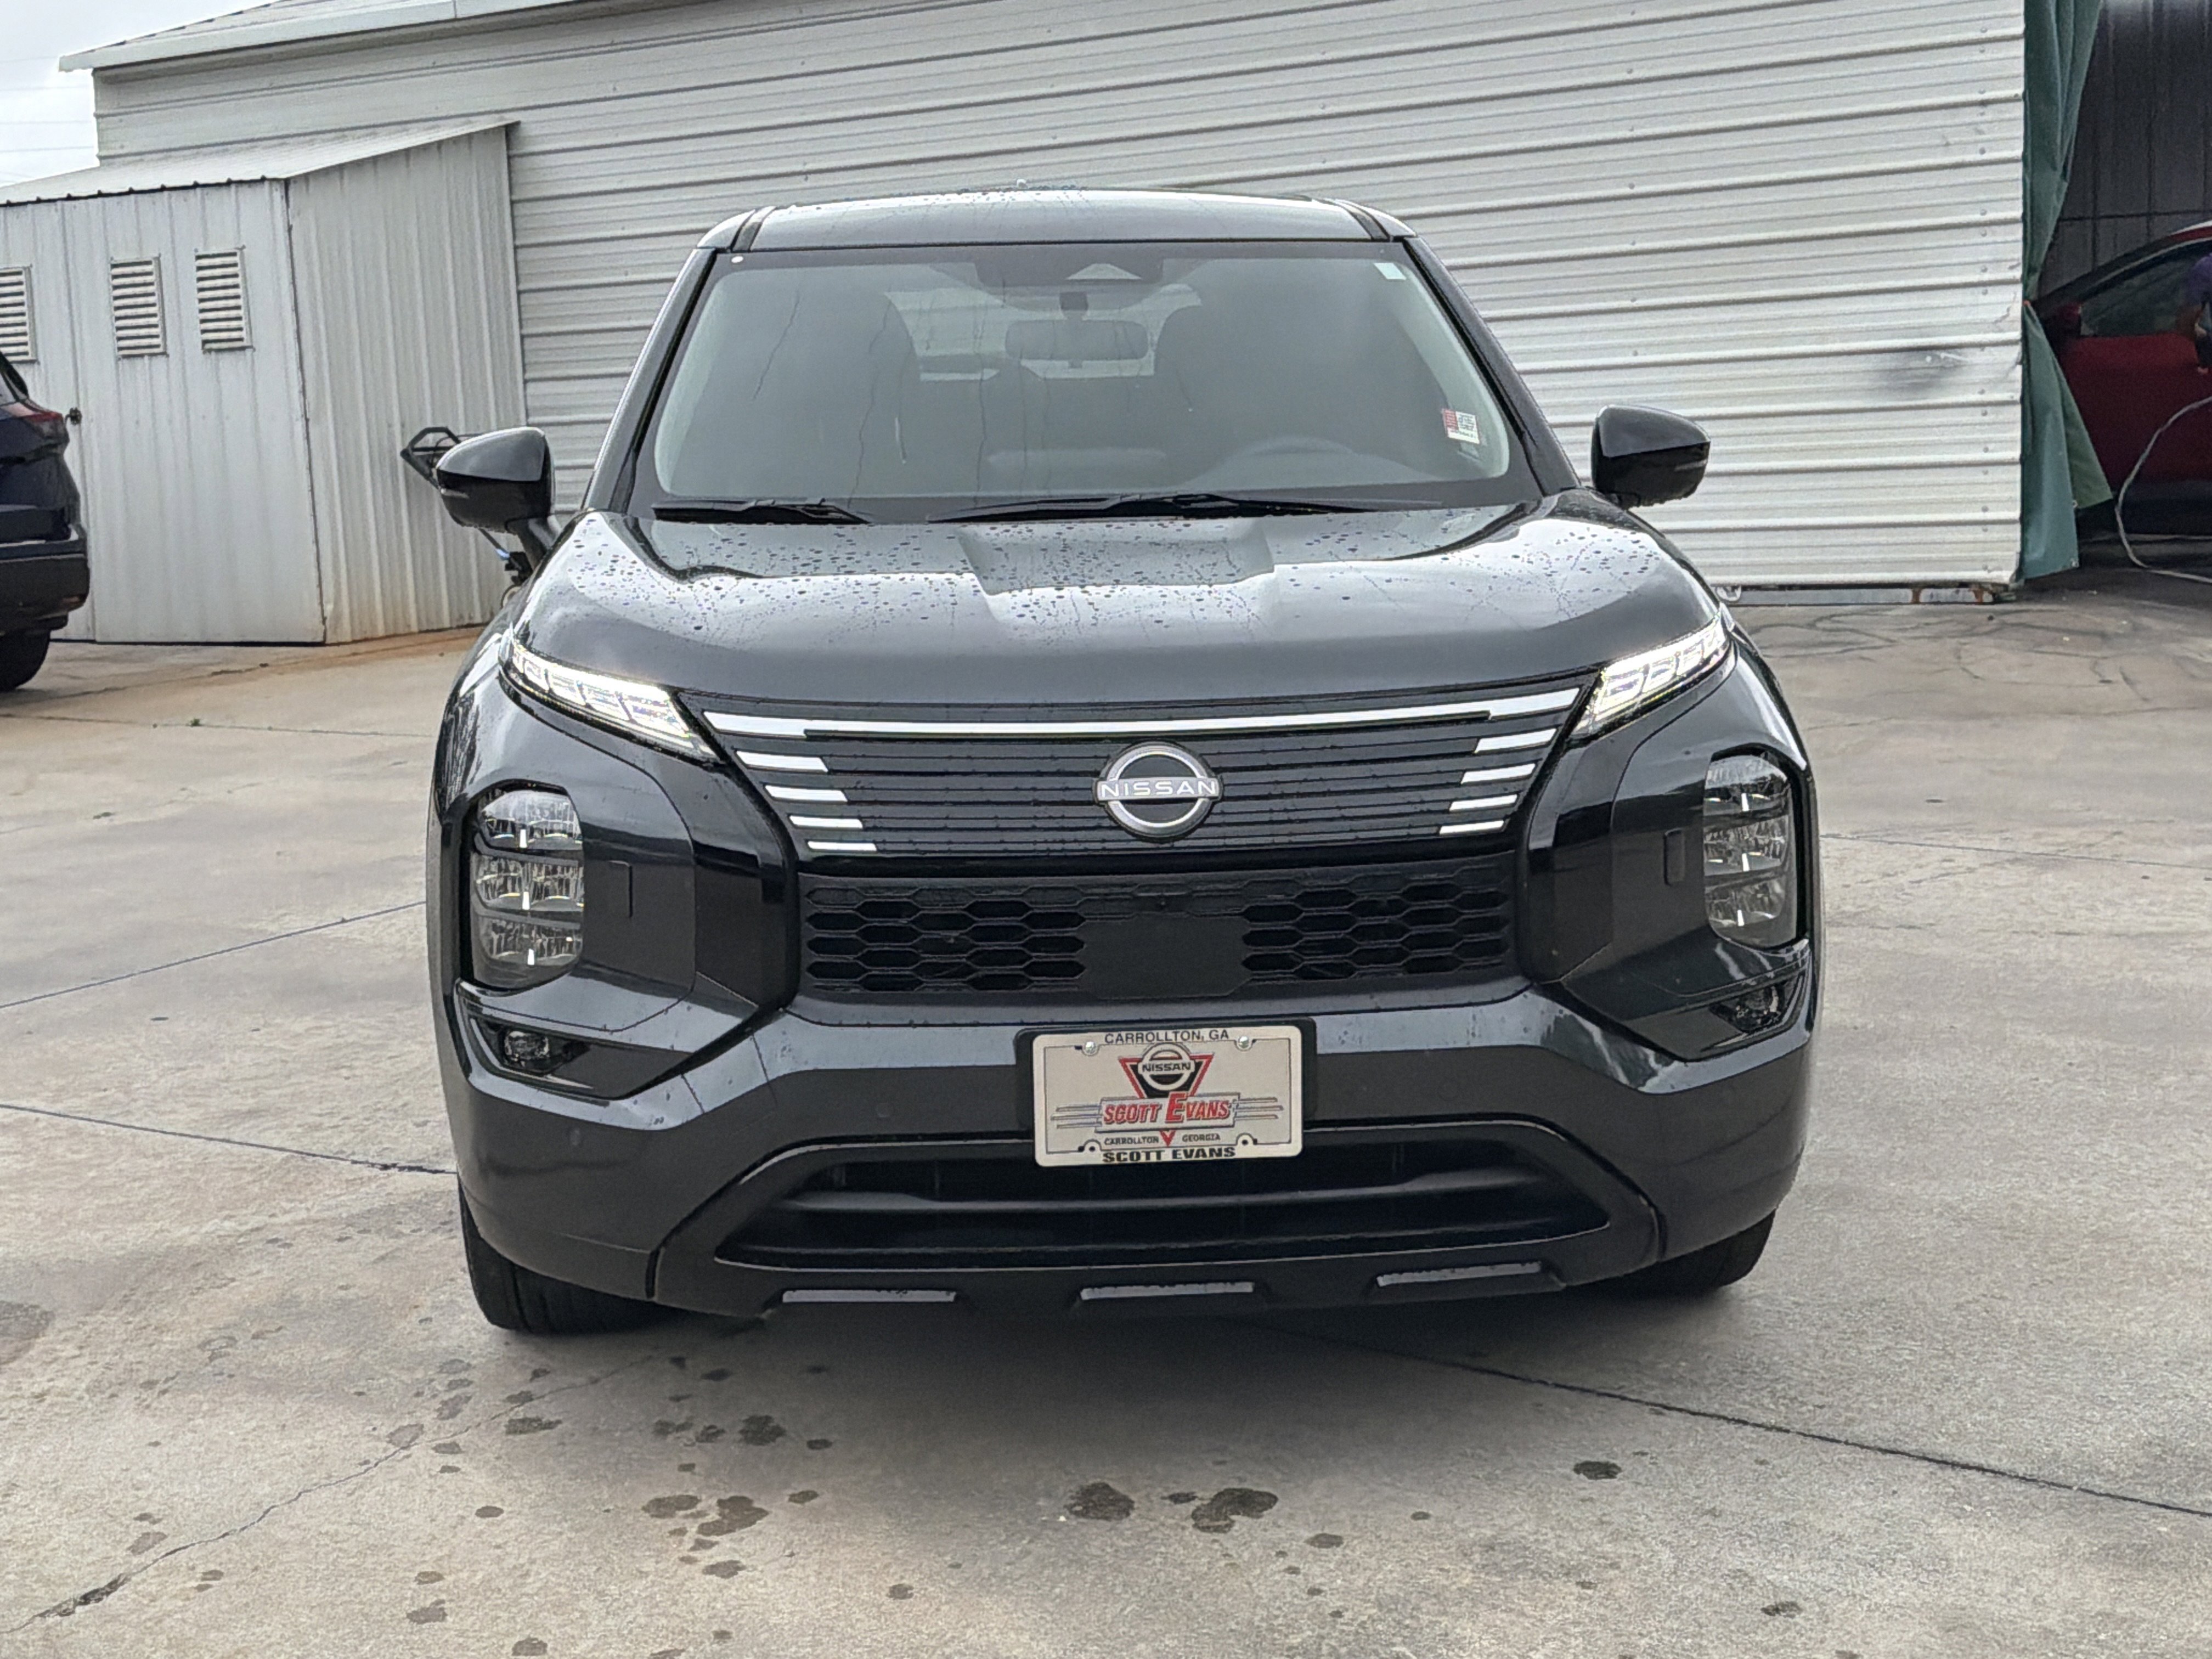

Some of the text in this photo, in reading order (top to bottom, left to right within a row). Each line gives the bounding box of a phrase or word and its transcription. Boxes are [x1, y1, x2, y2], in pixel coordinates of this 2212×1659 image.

[1101, 780, 1216, 798] NISSAN
[1104, 1029, 1229, 1043] CARROLLTON, GA
[1142, 1062, 1191, 1073] NISSAN
[1103, 1091, 1232, 1125] SCOTT EVANS
[1104, 1133, 1221, 1146] CARROLLTON GEORGIA
[1102, 1147, 1236, 1163] SCOTT EVANS
